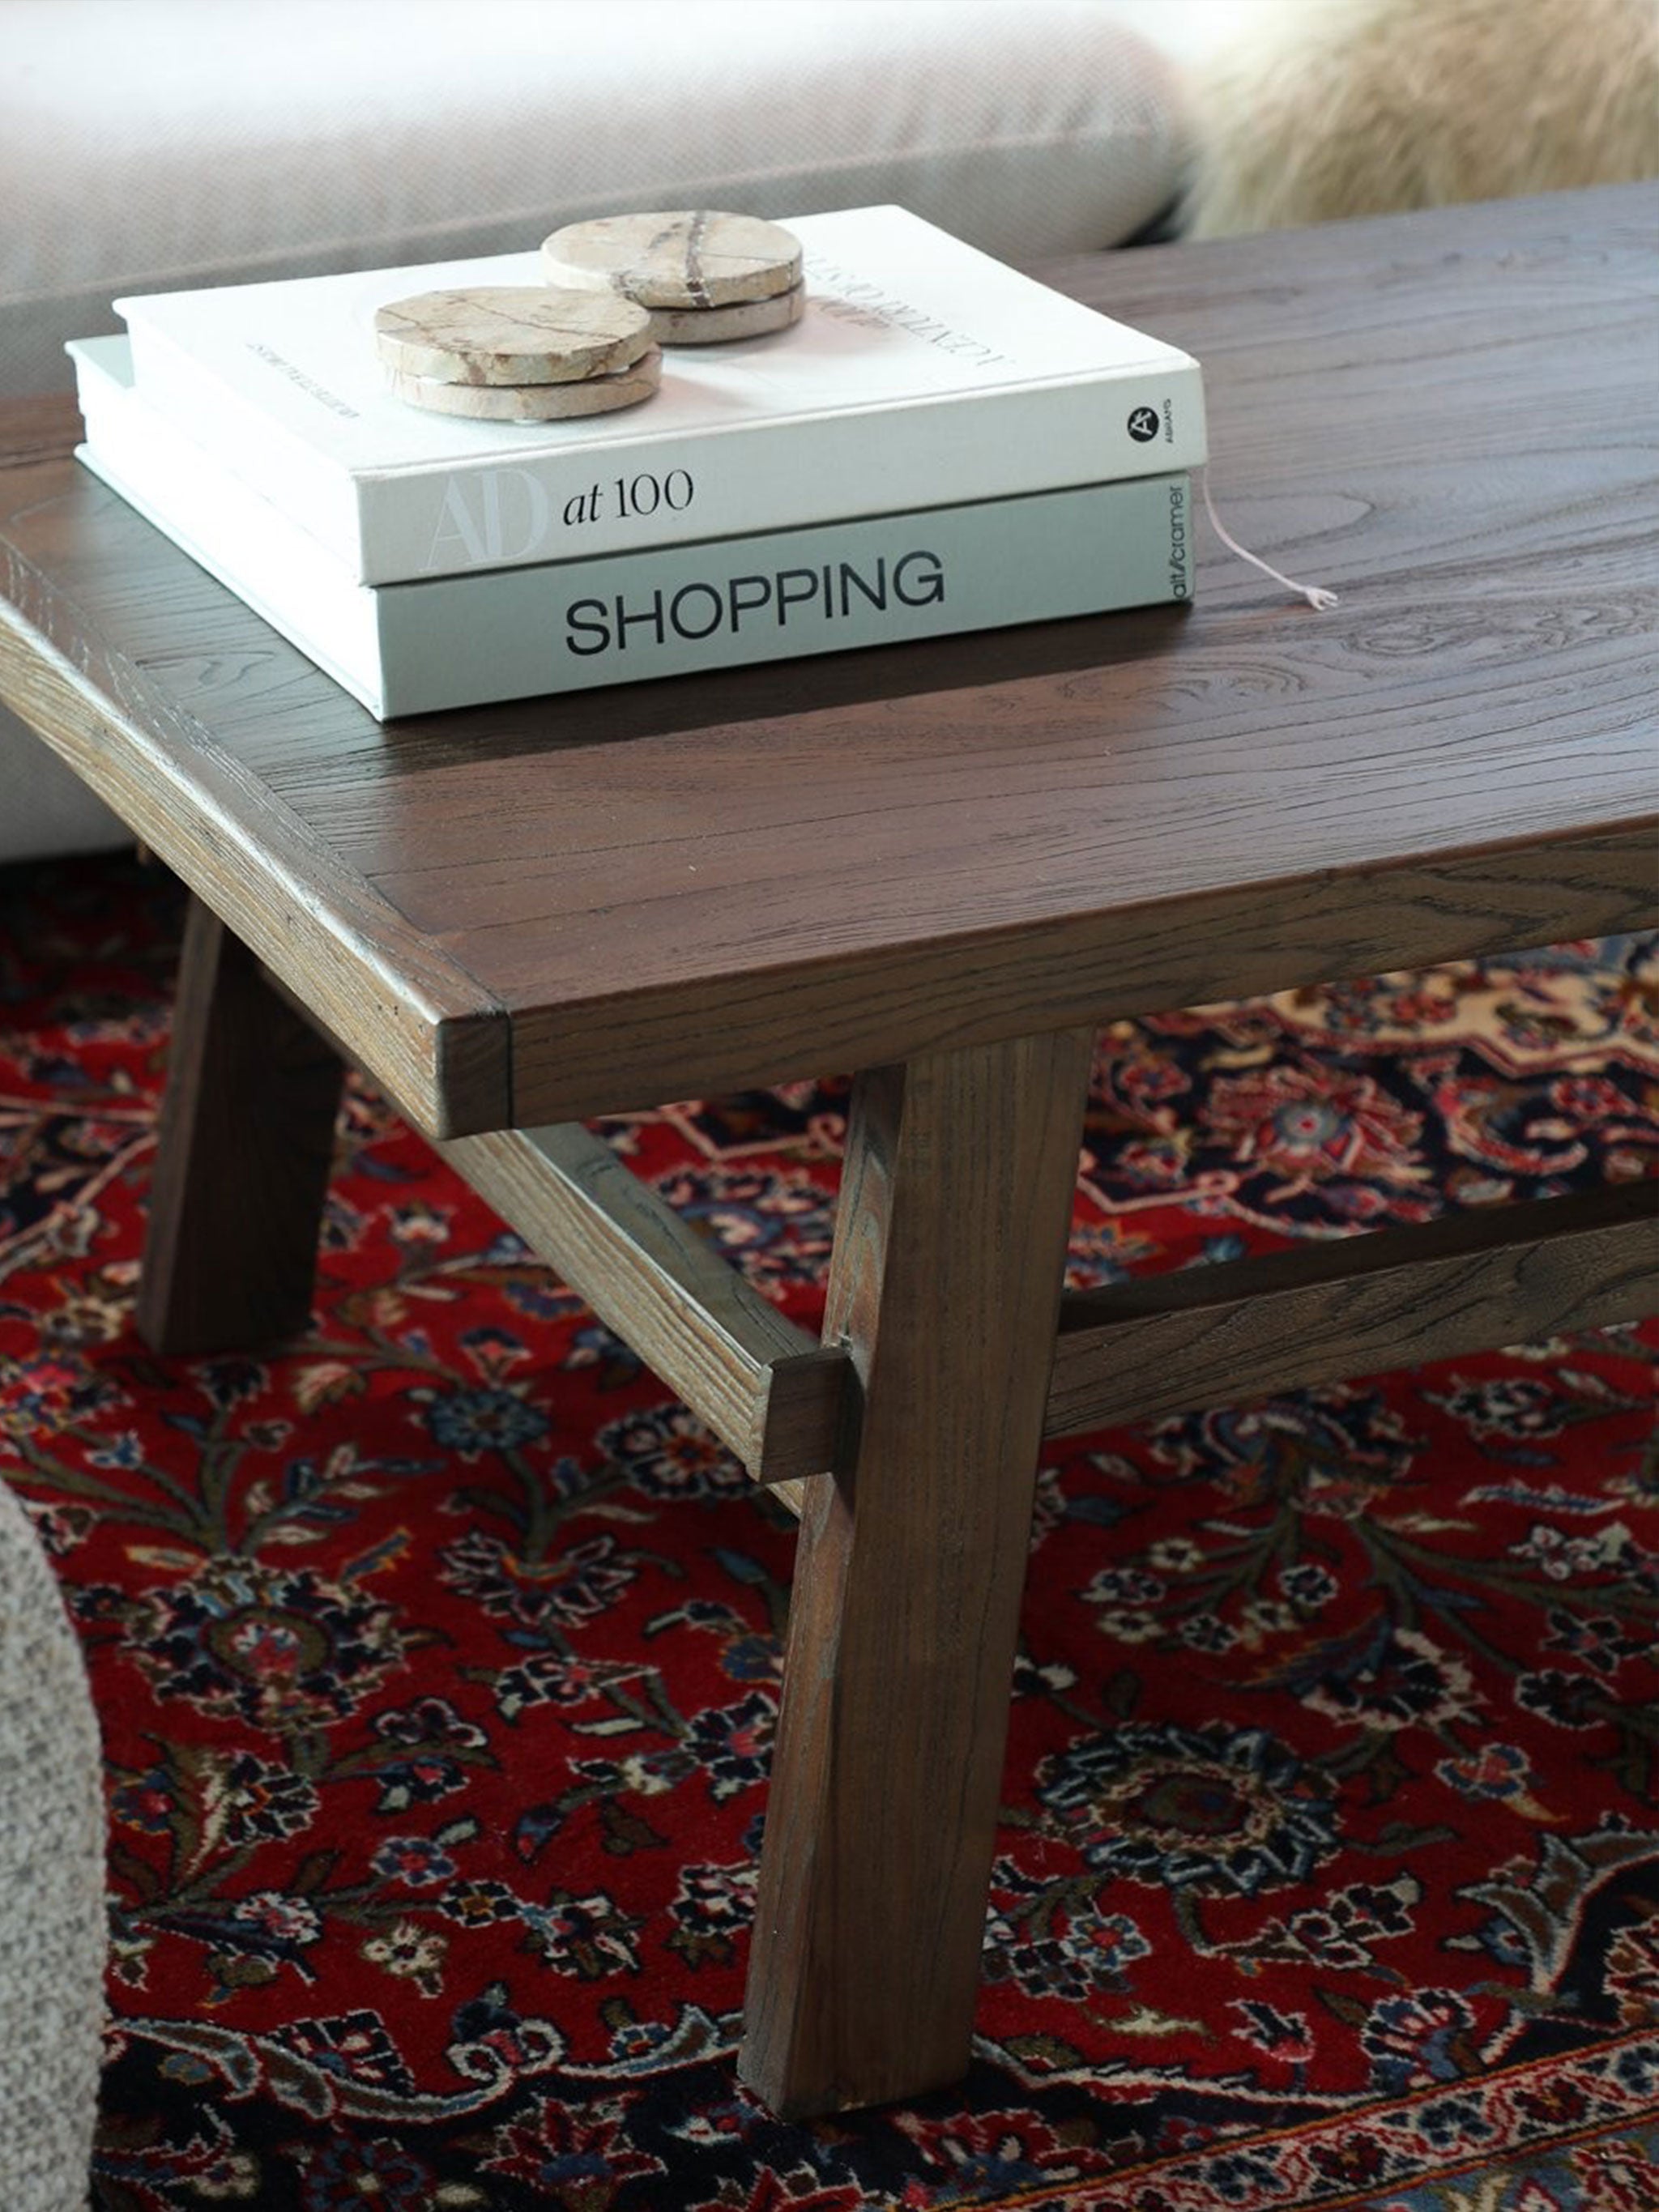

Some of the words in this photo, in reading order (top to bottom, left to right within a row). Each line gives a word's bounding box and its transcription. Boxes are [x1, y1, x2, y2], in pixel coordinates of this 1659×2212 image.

[417, 467, 549, 571] AD
[563, 484, 603, 526] at
[614, 468, 694, 519] 100
[565, 551, 945, 657] SHOPPING
